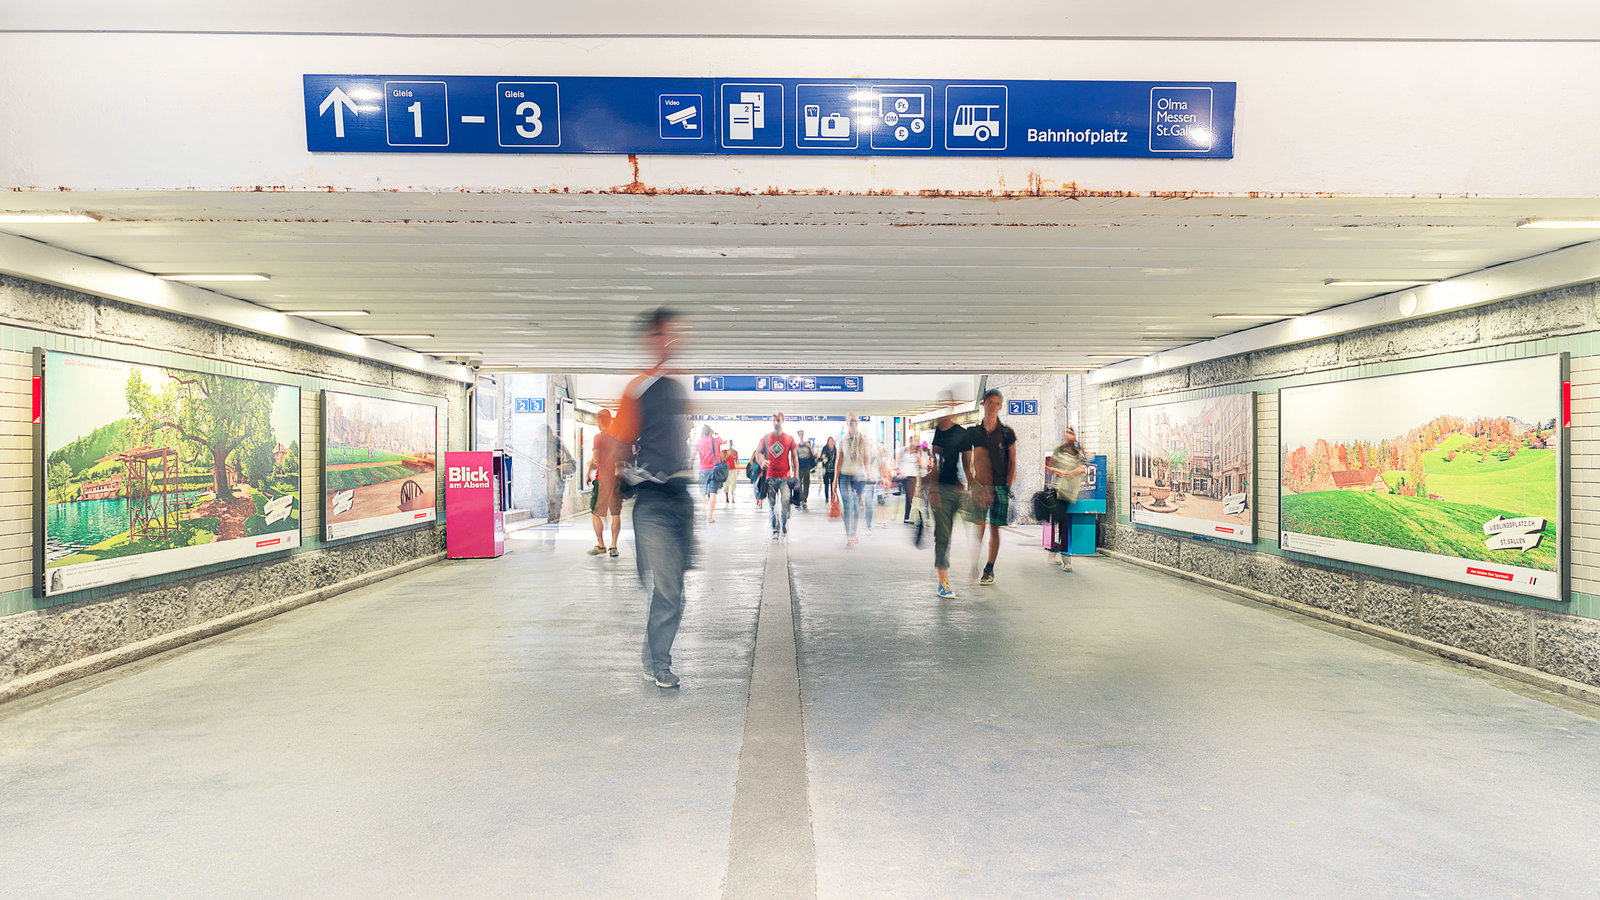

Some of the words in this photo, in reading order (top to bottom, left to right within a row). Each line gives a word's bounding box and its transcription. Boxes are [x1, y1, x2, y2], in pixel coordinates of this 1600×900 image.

[393, 89, 413, 98] Gleis
[505, 90, 524, 99] Gleis
[897, 101, 907, 109] Fr.
[1157, 98, 1188, 110] Olma
[744, 105, 750, 113] 2
[407, 101, 423, 138] 1
[515, 101, 543, 139] 3
[1156, 110, 1197, 123] Messen
[1027, 128, 1128, 145] Bahnhofplatz
[519, 402, 526, 411] 2
[533, 402, 540, 411] 3
[1013, 404, 1020, 413] 2
[1027, 404, 1034, 413] 3
[448, 466, 490, 482] Blick
[1500, 538, 1526, 546] ST.GALLEN
